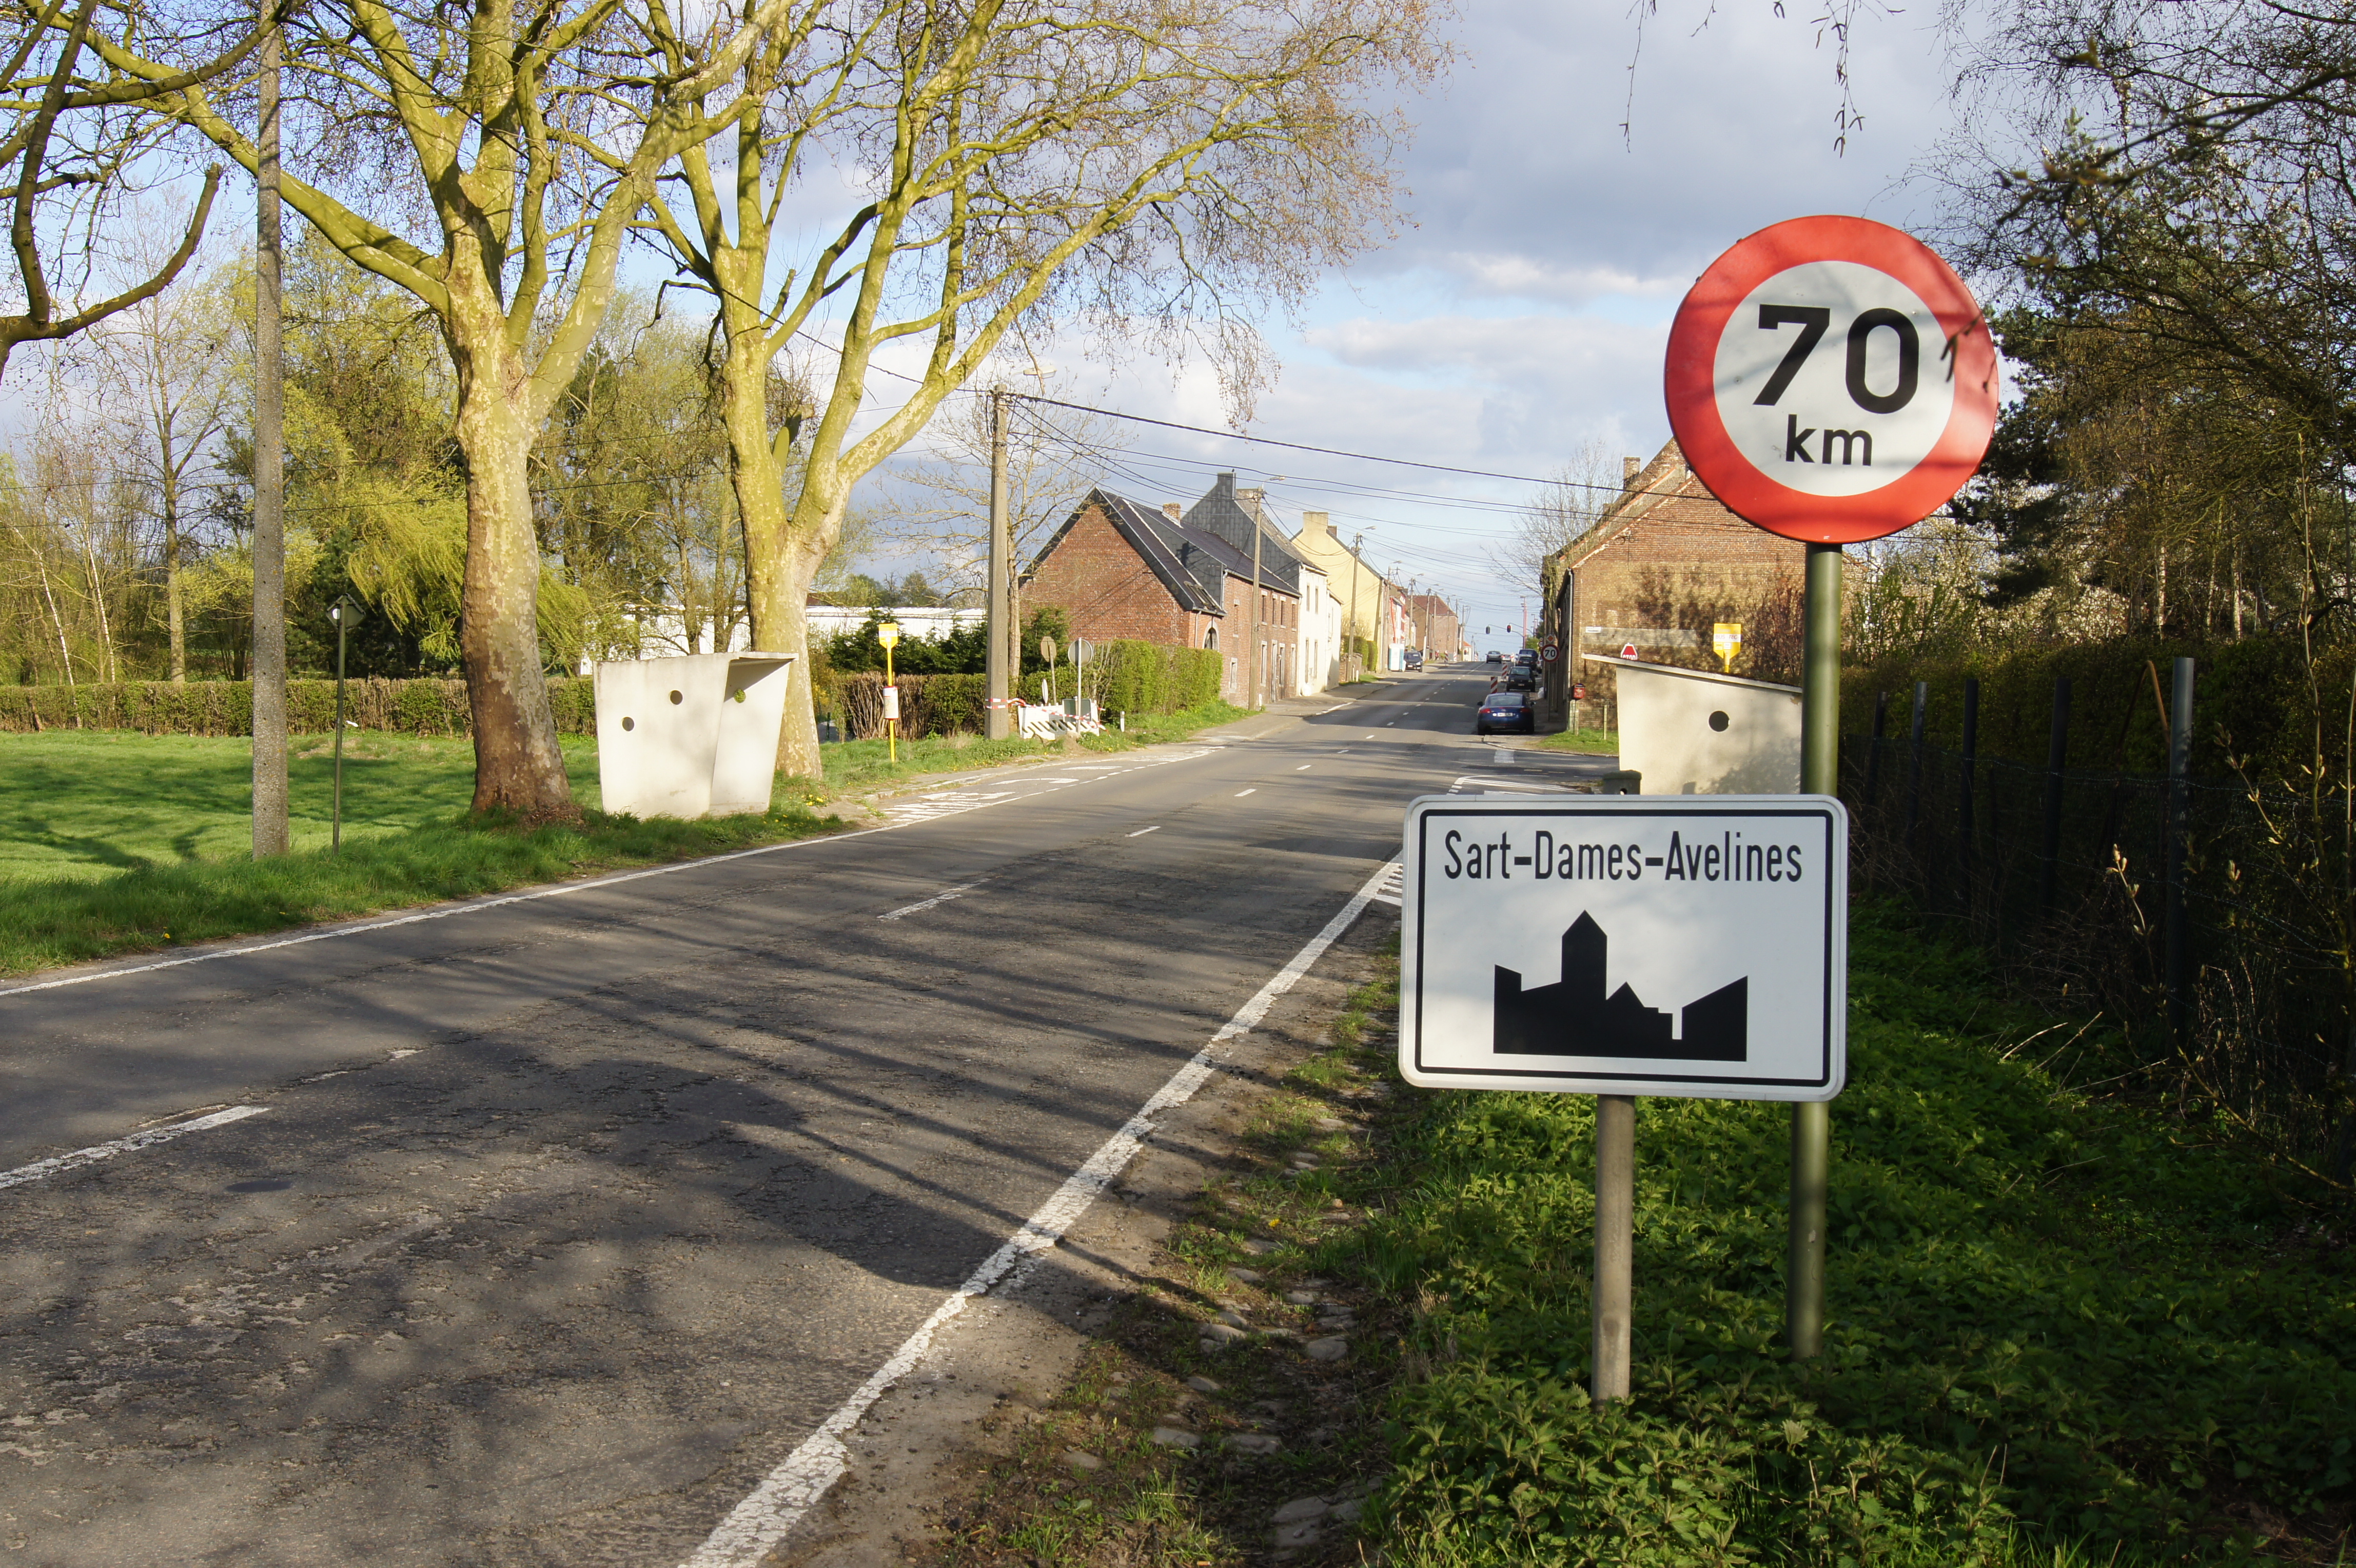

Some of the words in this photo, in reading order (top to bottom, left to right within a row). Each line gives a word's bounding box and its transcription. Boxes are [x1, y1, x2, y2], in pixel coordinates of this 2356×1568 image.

[1753, 304, 1919, 414] 70
[1785, 414, 1872, 466] km
[1444, 830, 1802, 883] Sart-Dames-Avelines
